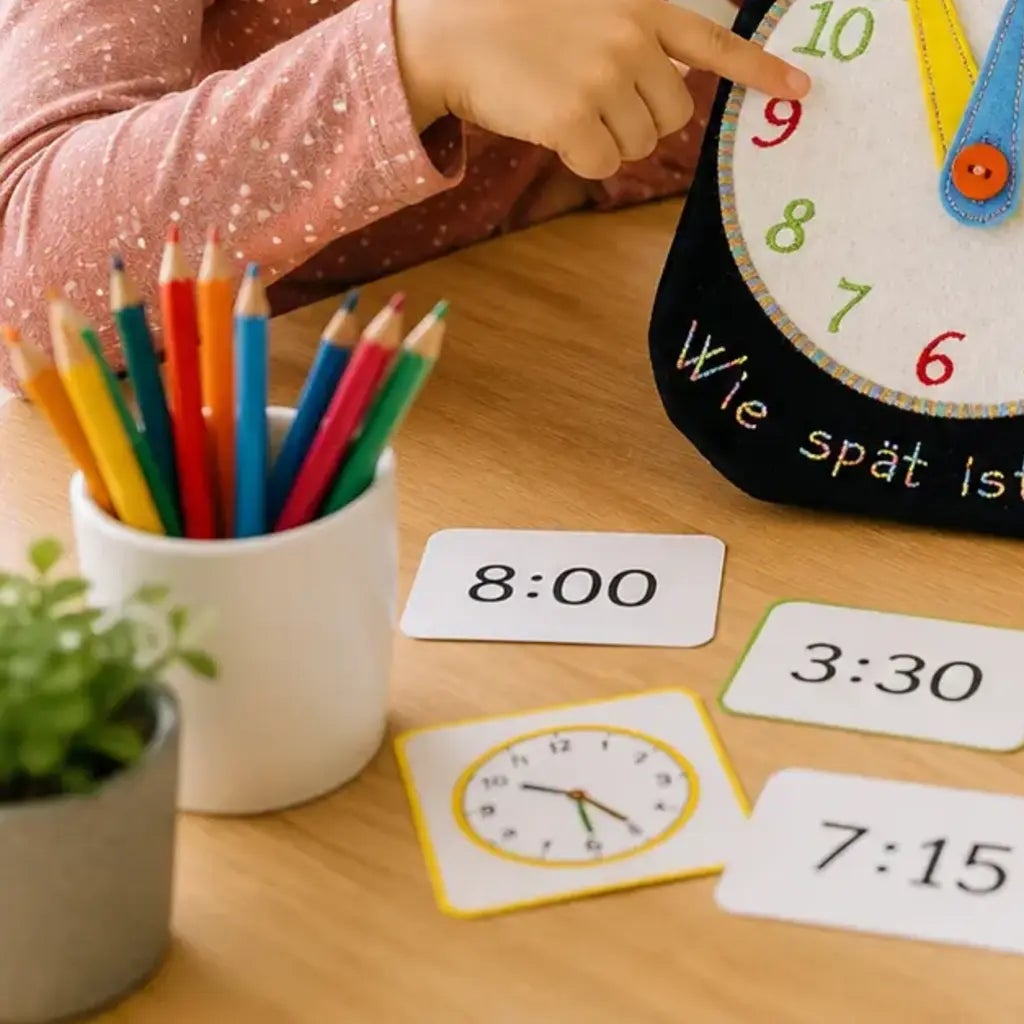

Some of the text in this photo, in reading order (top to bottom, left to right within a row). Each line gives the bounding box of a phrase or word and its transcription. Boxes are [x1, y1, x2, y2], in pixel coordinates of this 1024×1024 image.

[792, 0, 875, 62] 10
[751, 97, 802, 148] 9
[765, 198, 815, 254] 8
[828, 278, 871, 333] 7
[915, 331, 966, 387] 6
[675, 320, 768, 429] Wie
[799, 430, 928, 488] spät
[467, 563, 659, 609] 8:00
[789, 641, 984, 703] 3:30
[811, 821, 1015, 897] 7:15
